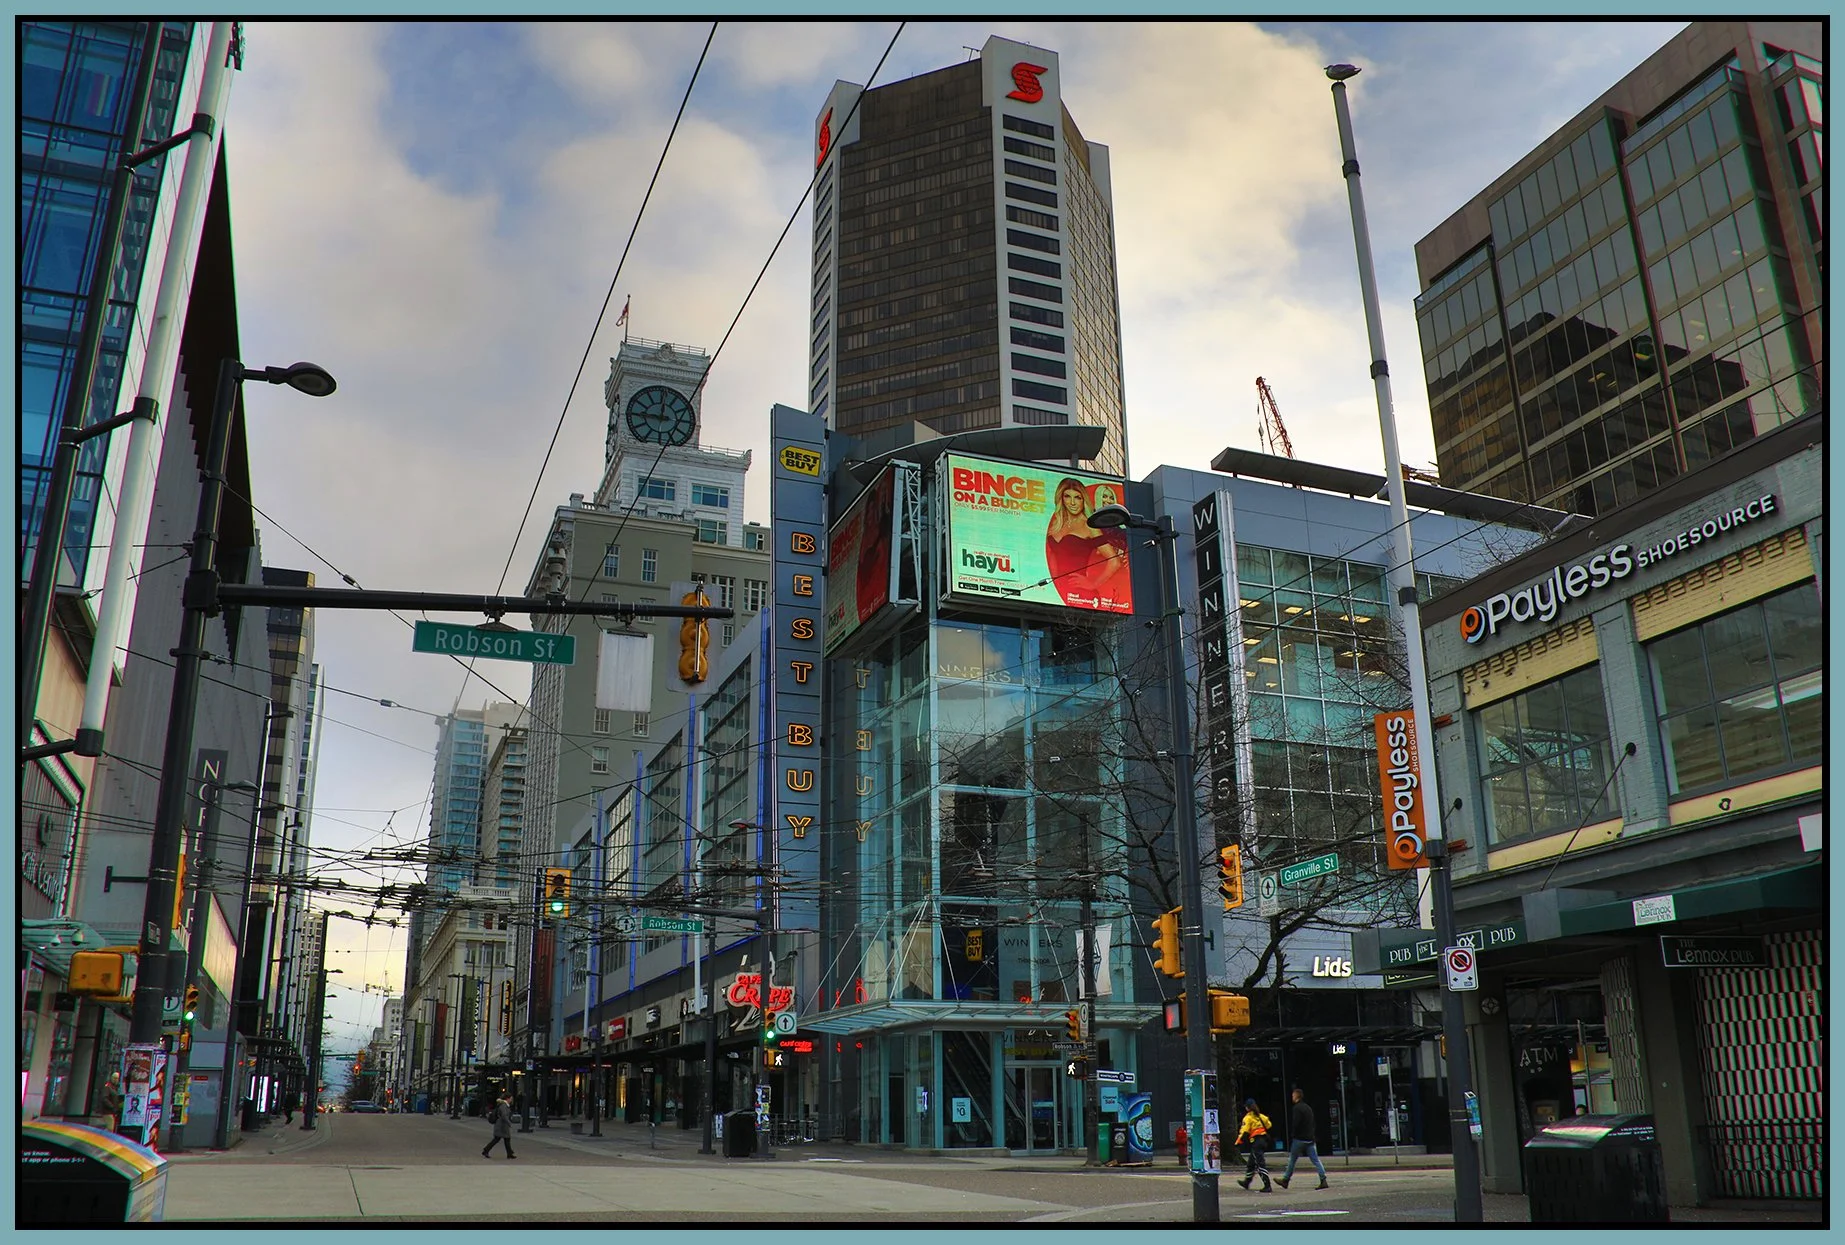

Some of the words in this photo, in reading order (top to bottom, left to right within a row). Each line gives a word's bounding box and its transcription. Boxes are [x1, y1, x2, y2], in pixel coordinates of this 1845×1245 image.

[786, 450, 819, 464] BEST
[786, 459, 816, 471] BUY
[953, 467, 1045, 502] BINGE
[953, 491, 975, 505] ON
[978, 494, 989, 507] A
[991, 496, 1045, 514] BUDGET
[954, 501, 971, 510] ONLY
[971, 503, 987, 512] $5.99
[1000, 508, 1021, 516] MONTH
[1486, 544, 1632, 635] Payless
[1637, 494, 1776, 569] SHOESOURCE
[791, 531, 817, 684] BEST
[435, 628, 522, 656] Robson
[533, 638, 555, 659] St
[1194, 502, 1230, 800] WINNERS
[1407, 718, 1419, 772] SHOESOURCE
[787, 723, 813, 840] BUY
[1386, 716, 1418, 832] Payless
[1284, 862, 1321, 882] Granville
[1323, 857, 1335, 870] St
[1640, 904, 1672, 918] Lennox
[649, 919, 683, 930] Robson
[687, 921, 696, 931] St
[968, 936, 982, 946] BEST
[968, 947, 981, 957] BUY
[1003, 938, 1064, 948] WINERS
[1389, 948, 1412, 963] PUB
[1490, 927, 1516, 944] PUB
[1676, 948, 1728, 963] Lennox
[1731, 950, 1755, 963] PUB
[1312, 956, 1352, 978] Lids
[730, 984, 793, 1008] CRPE
[1332, 1044, 1346, 1054] Lids
[1519, 1046, 1559, 1065] ATM
